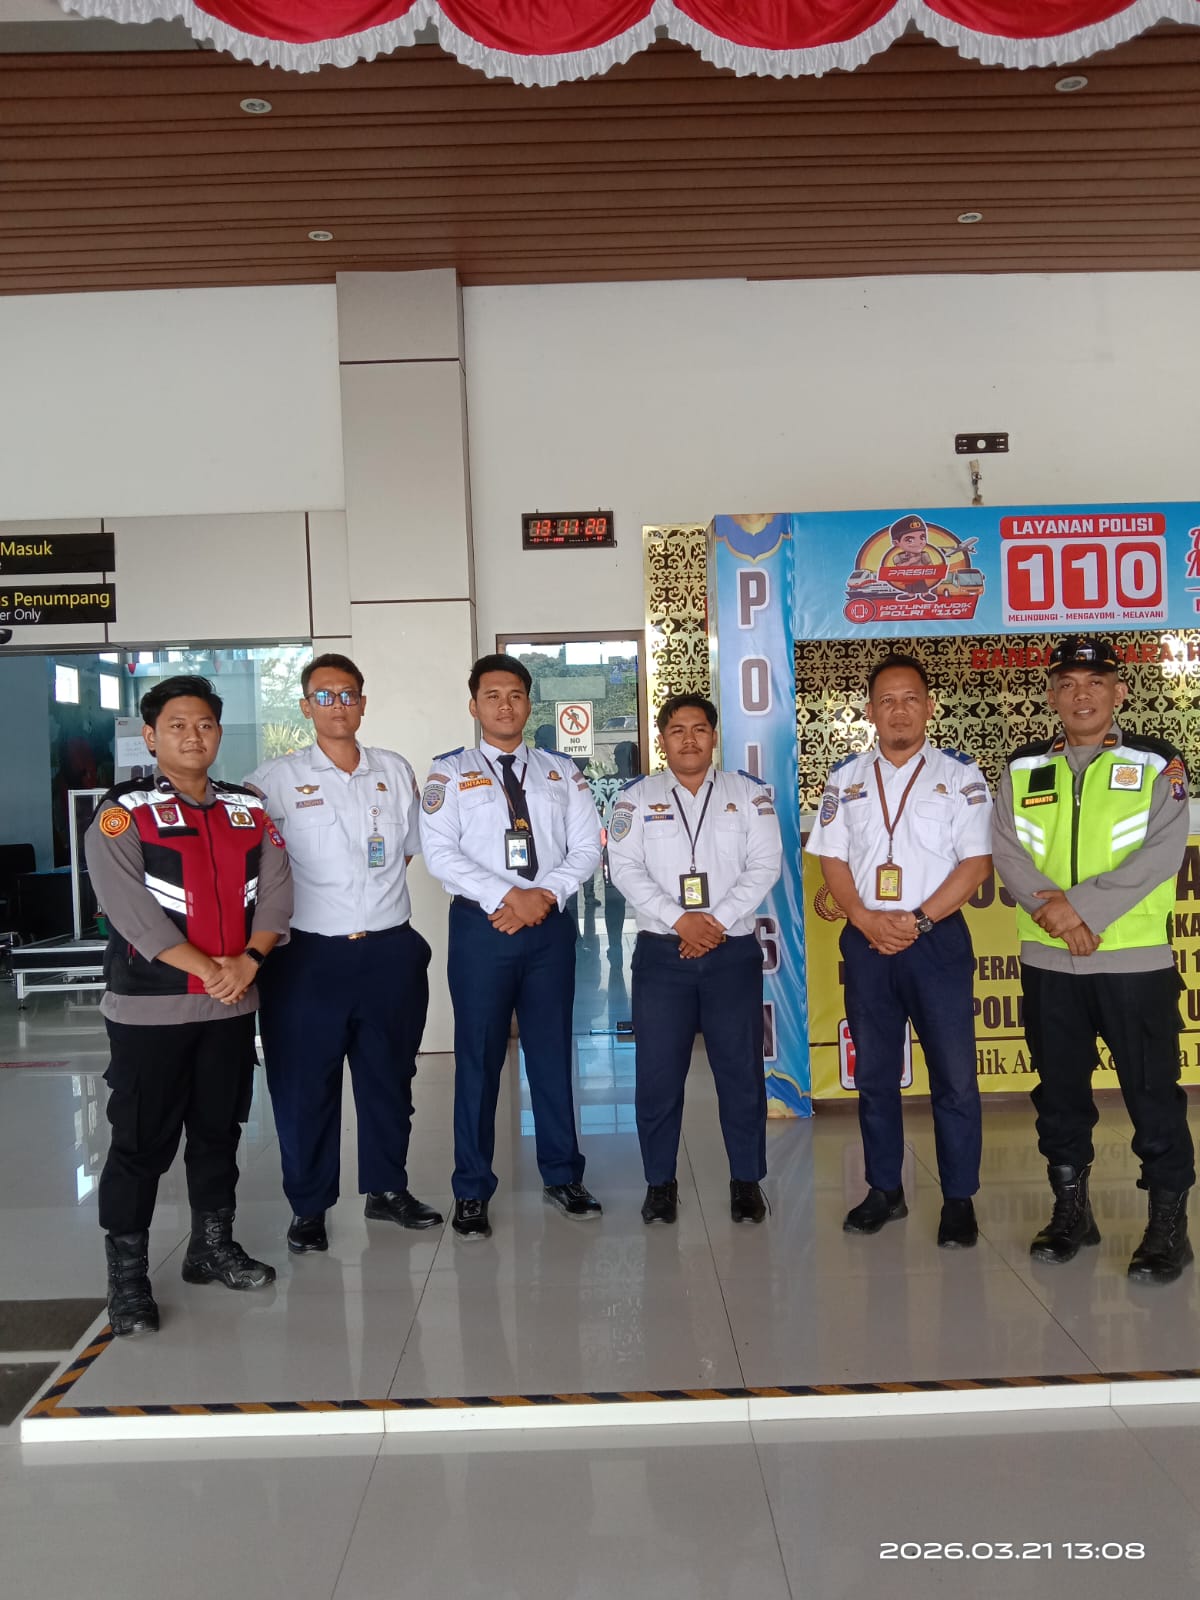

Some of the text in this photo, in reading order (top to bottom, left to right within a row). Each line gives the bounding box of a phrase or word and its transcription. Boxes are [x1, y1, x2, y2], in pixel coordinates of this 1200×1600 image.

[1013, 517, 1153, 535] LAYANAN POLISI
[0, 540, 53, 556] Masuk
[888, 568, 936, 577] PRESISI
[1017, 550, 1157, 602] 110
[14, 592, 110, 608] Penumpang
[880, 603, 931, 611] HOTLINE
[14, 608, 41, 622] Only
[880, 609, 924, 617] POLRI
[1008, 611, 1163, 622] MELINDUNGI MENGAYOMI MELAYANI
